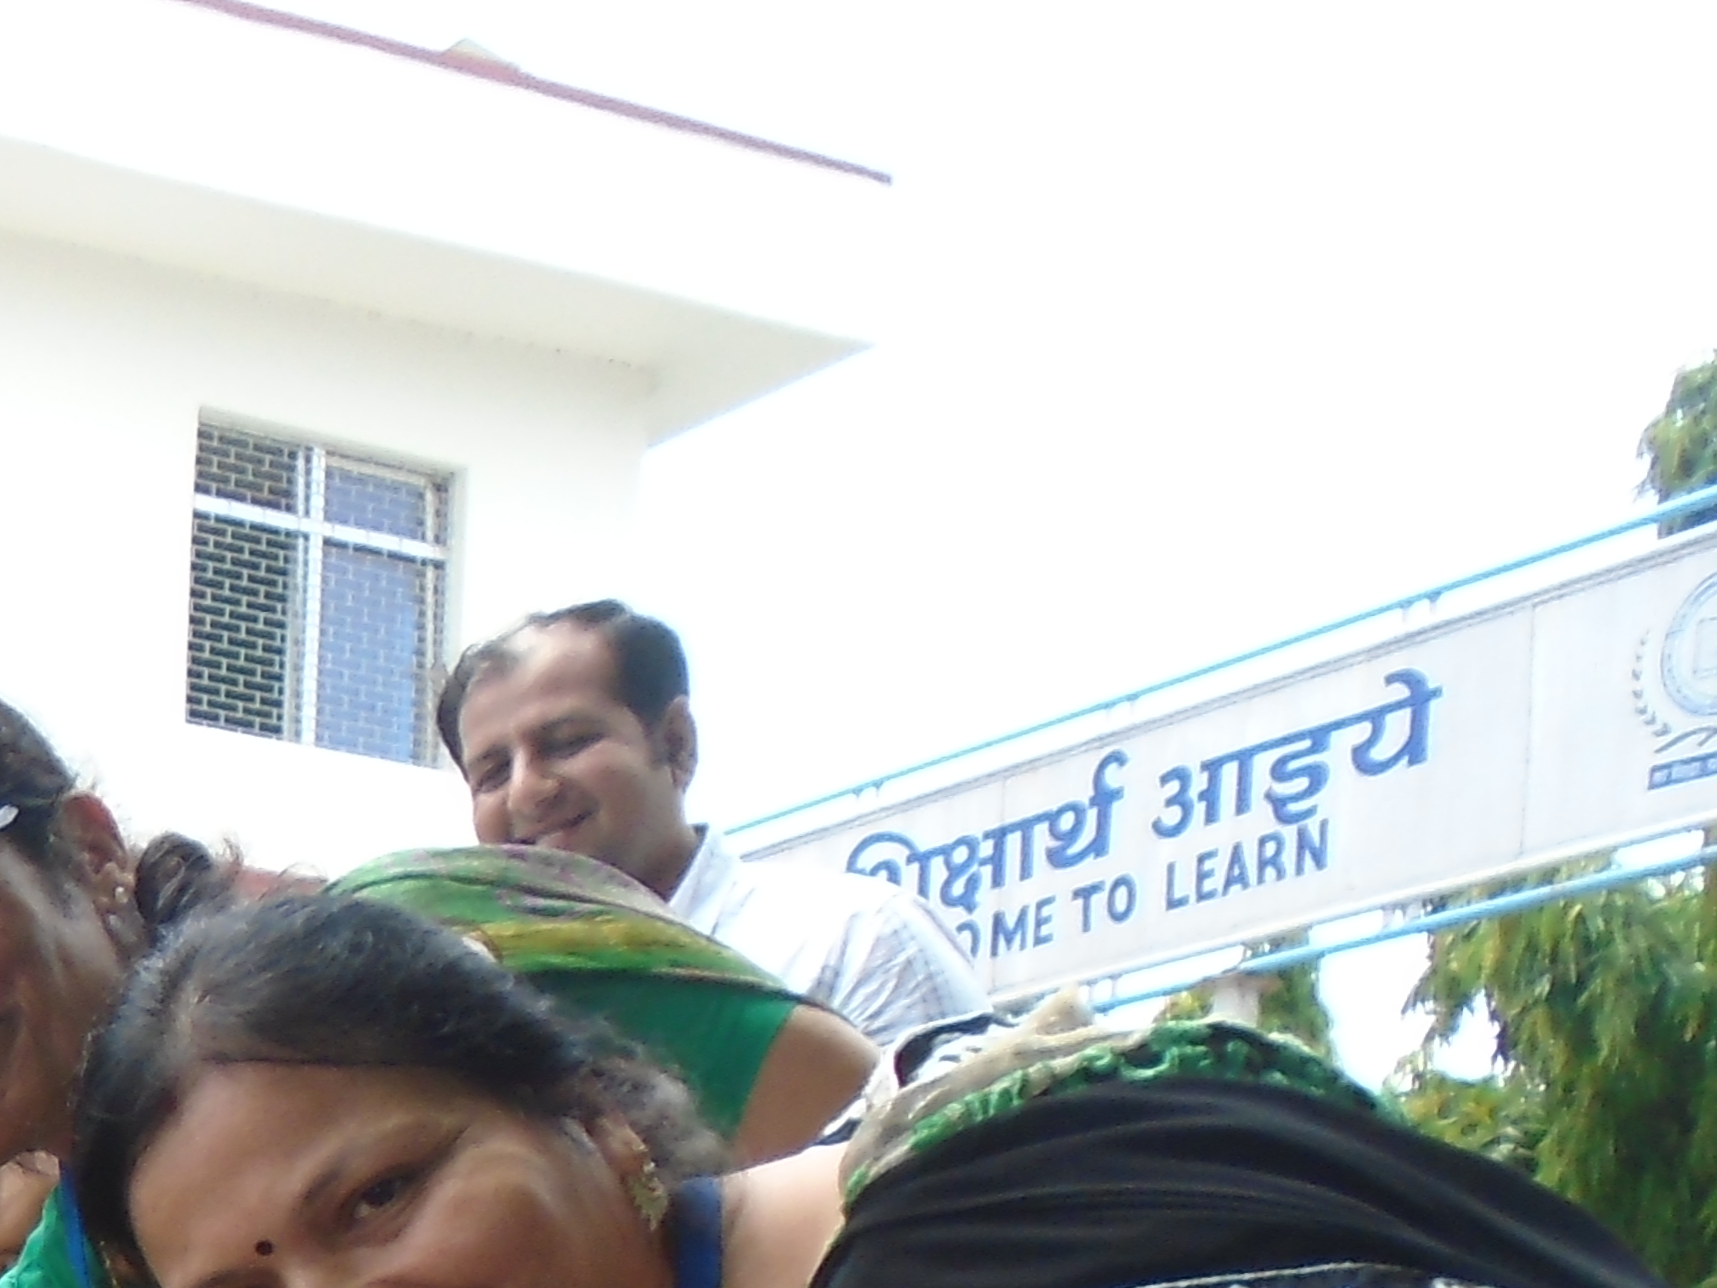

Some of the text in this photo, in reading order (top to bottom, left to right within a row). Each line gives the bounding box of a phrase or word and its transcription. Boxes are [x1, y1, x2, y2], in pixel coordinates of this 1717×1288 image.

[1151, 667, 1443, 840] आइये
[955, 818, 1331, 959] OME TO LEARN
